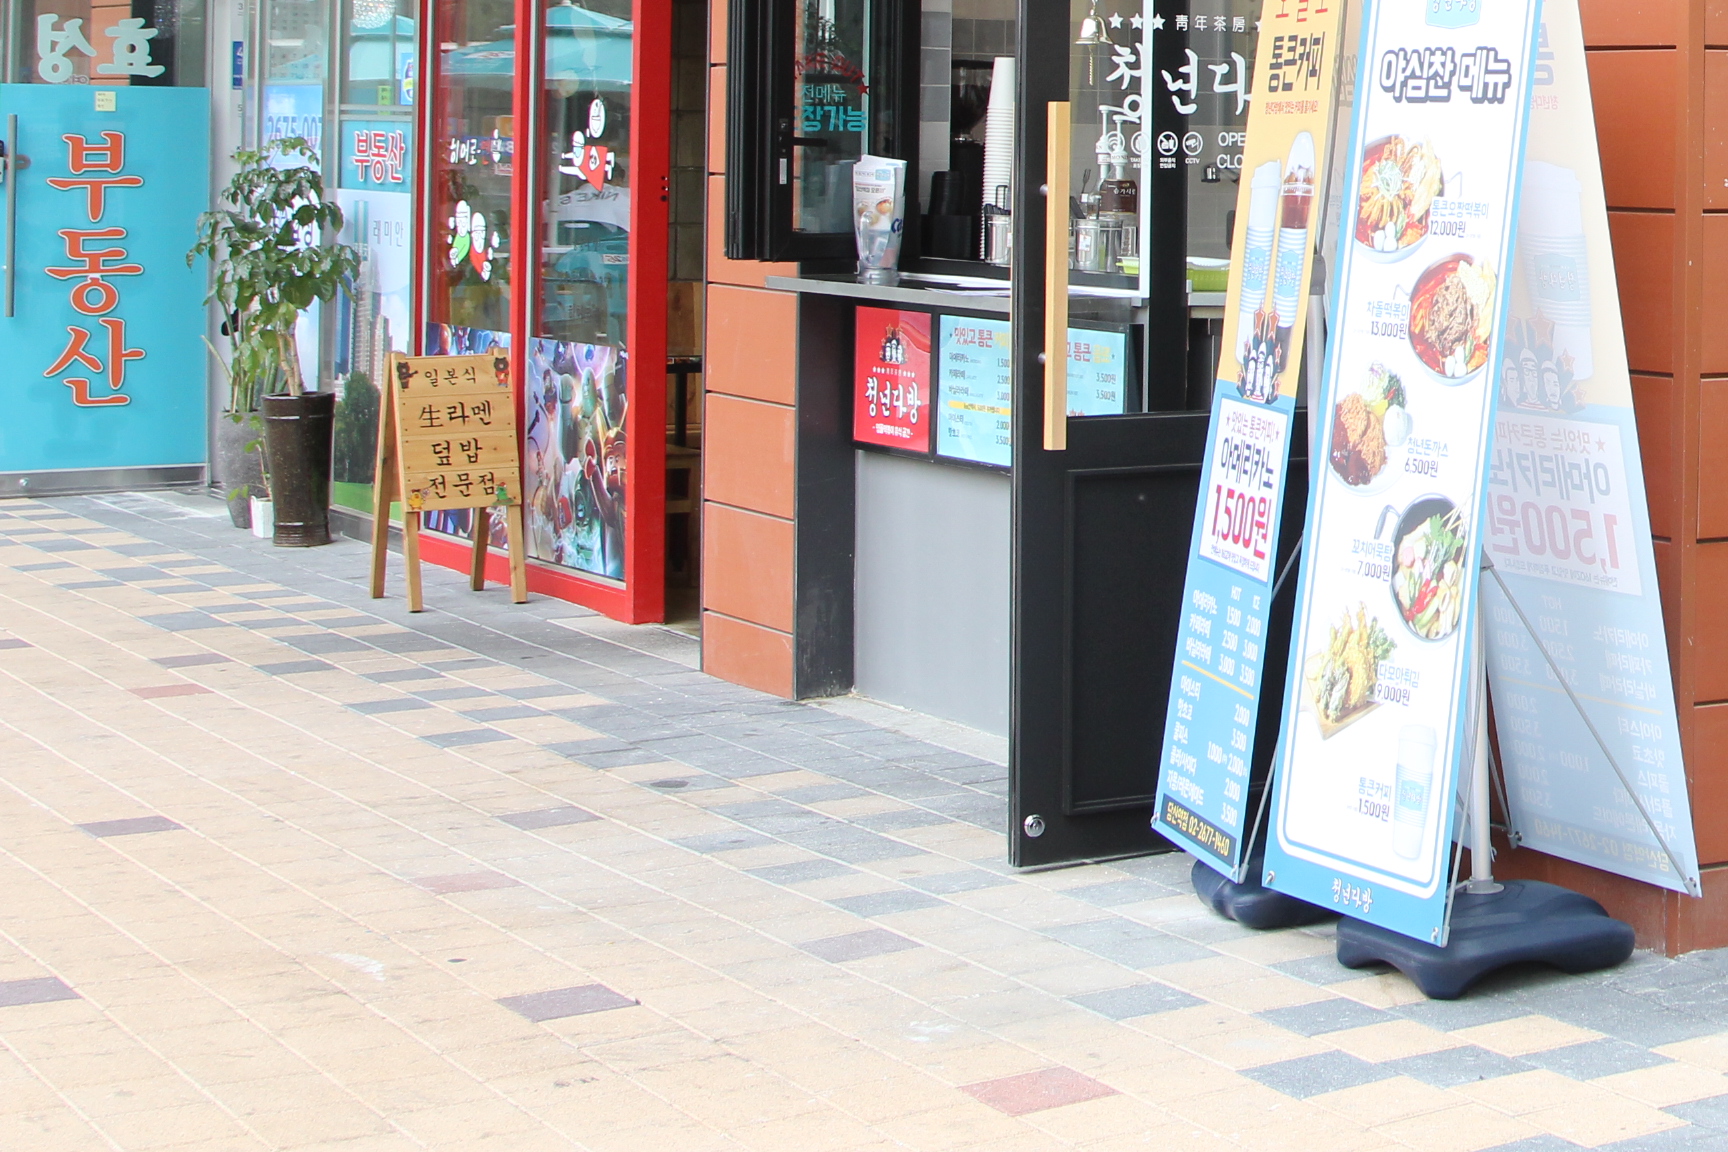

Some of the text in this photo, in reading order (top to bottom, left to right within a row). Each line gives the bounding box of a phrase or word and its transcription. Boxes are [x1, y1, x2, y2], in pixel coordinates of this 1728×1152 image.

[1175, 14, 1246, 33] 青年茶房
[1268, 31, 1326, 94] 통큰커피
[1379, 46, 1457, 104] 야심찬
[1457, 46, 1512, 105] 메뉴
[1106, 42, 1251, 116] 청년다
[794, 106, 868, 132] 장가능
[1218, 132, 1246, 146] OPE
[353, 130, 405, 184] 부동산
[1217, 153, 1243, 169] CLO
[1431, 199, 1489, 219] 통큰오짱떡볶이
[372, 218, 404, 248] 래미안
[1430, 220, 1466, 239] 12,000원
[44, 131, 146, 408] 부동산
[1366, 300, 1409, 322] 차돌떡볶이
[1371, 321, 1408, 340] 13,000원
[424, 366, 477, 388] 일본식
[865, 376, 922, 424] 청년다방
[418, 399, 492, 428] 生라멘
[430, 437, 483, 467] 덮밥
[1407, 436, 1449, 458] 청년돈까스
[1220, 436, 1275, 491] 아메리카노
[1404, 457, 1439, 478] 6,500원
[428, 470, 497, 500] 전문점
[1211, 484, 1273, 561] 1,500원
[1351, 538, 1393, 563] 꼬치어묵탕
[1357, 560, 1391, 582] 7,000원
[1378, 662, 1420, 689] 다모아튀김
[1358, 777, 1392, 800] 통큰커피
[1358, 798, 1390, 822] 1,500원
[1188, 816, 1231, 857] 02-2677-1460
[1331, 877, 1374, 914] 청년다방
